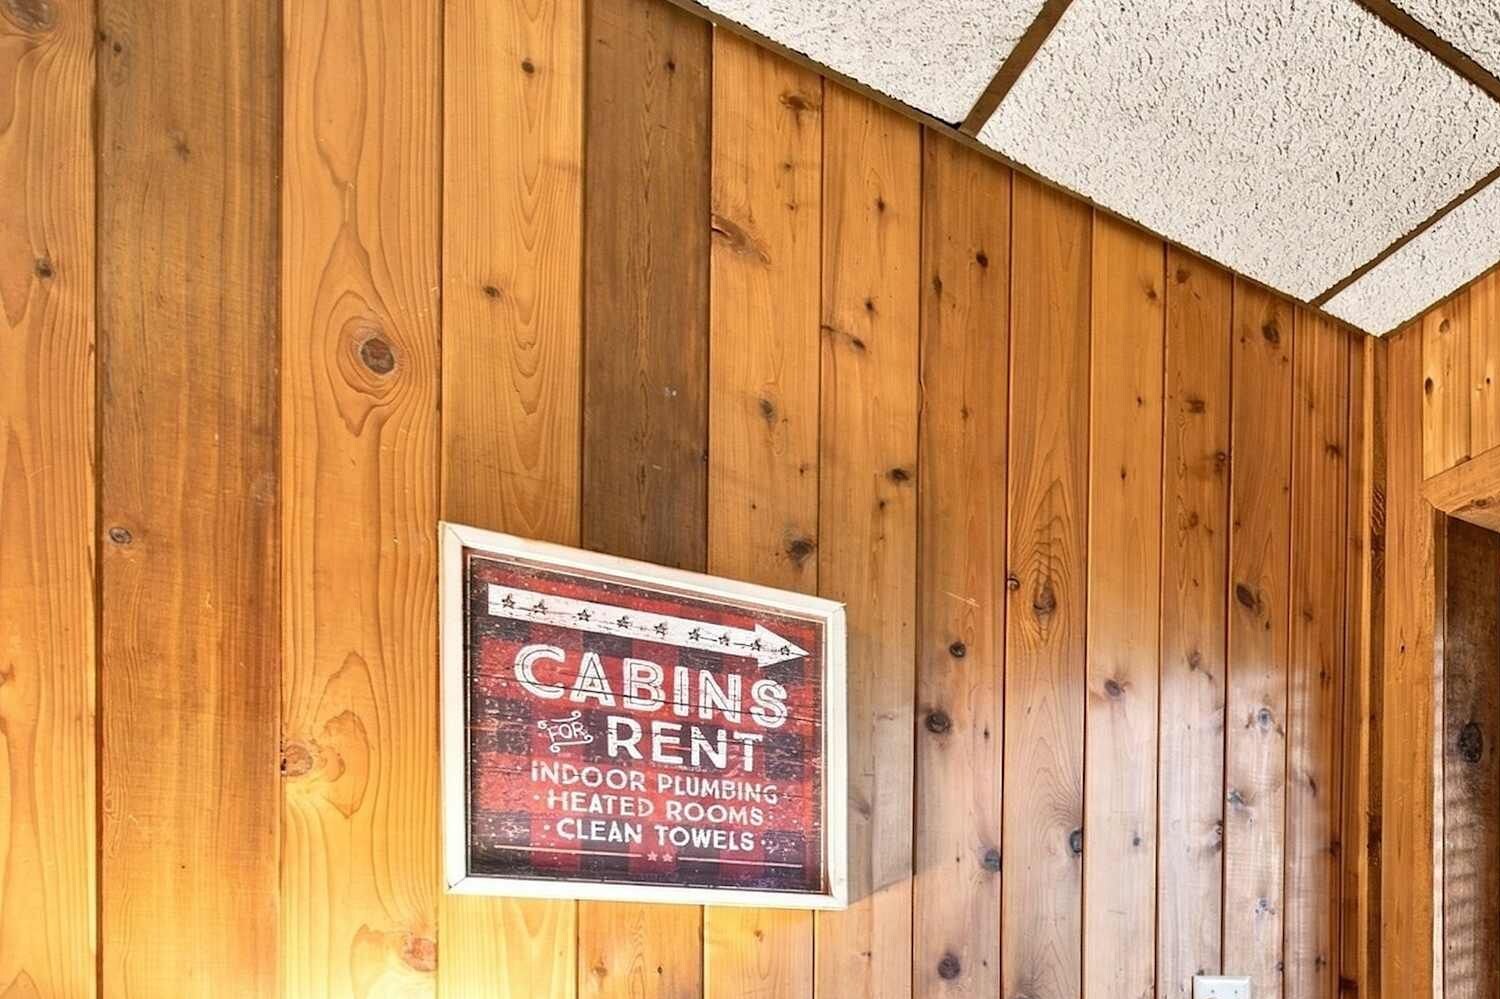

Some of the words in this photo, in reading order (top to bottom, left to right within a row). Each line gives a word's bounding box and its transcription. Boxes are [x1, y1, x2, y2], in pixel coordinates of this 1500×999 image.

[514, 645, 788, 728] CABINS
[543, 718, 588, 745] FOR
[607, 716, 763, 772] RENT
[531, 761, 645, 792] INDOOR
[658, 774, 778, 804] PLUMBING
[547, 790, 655, 817] HEATED
[666, 801, 764, 826] ROOMS
[556, 817, 642, 844] CLEAN
[656, 826, 755, 851] TOWELS
